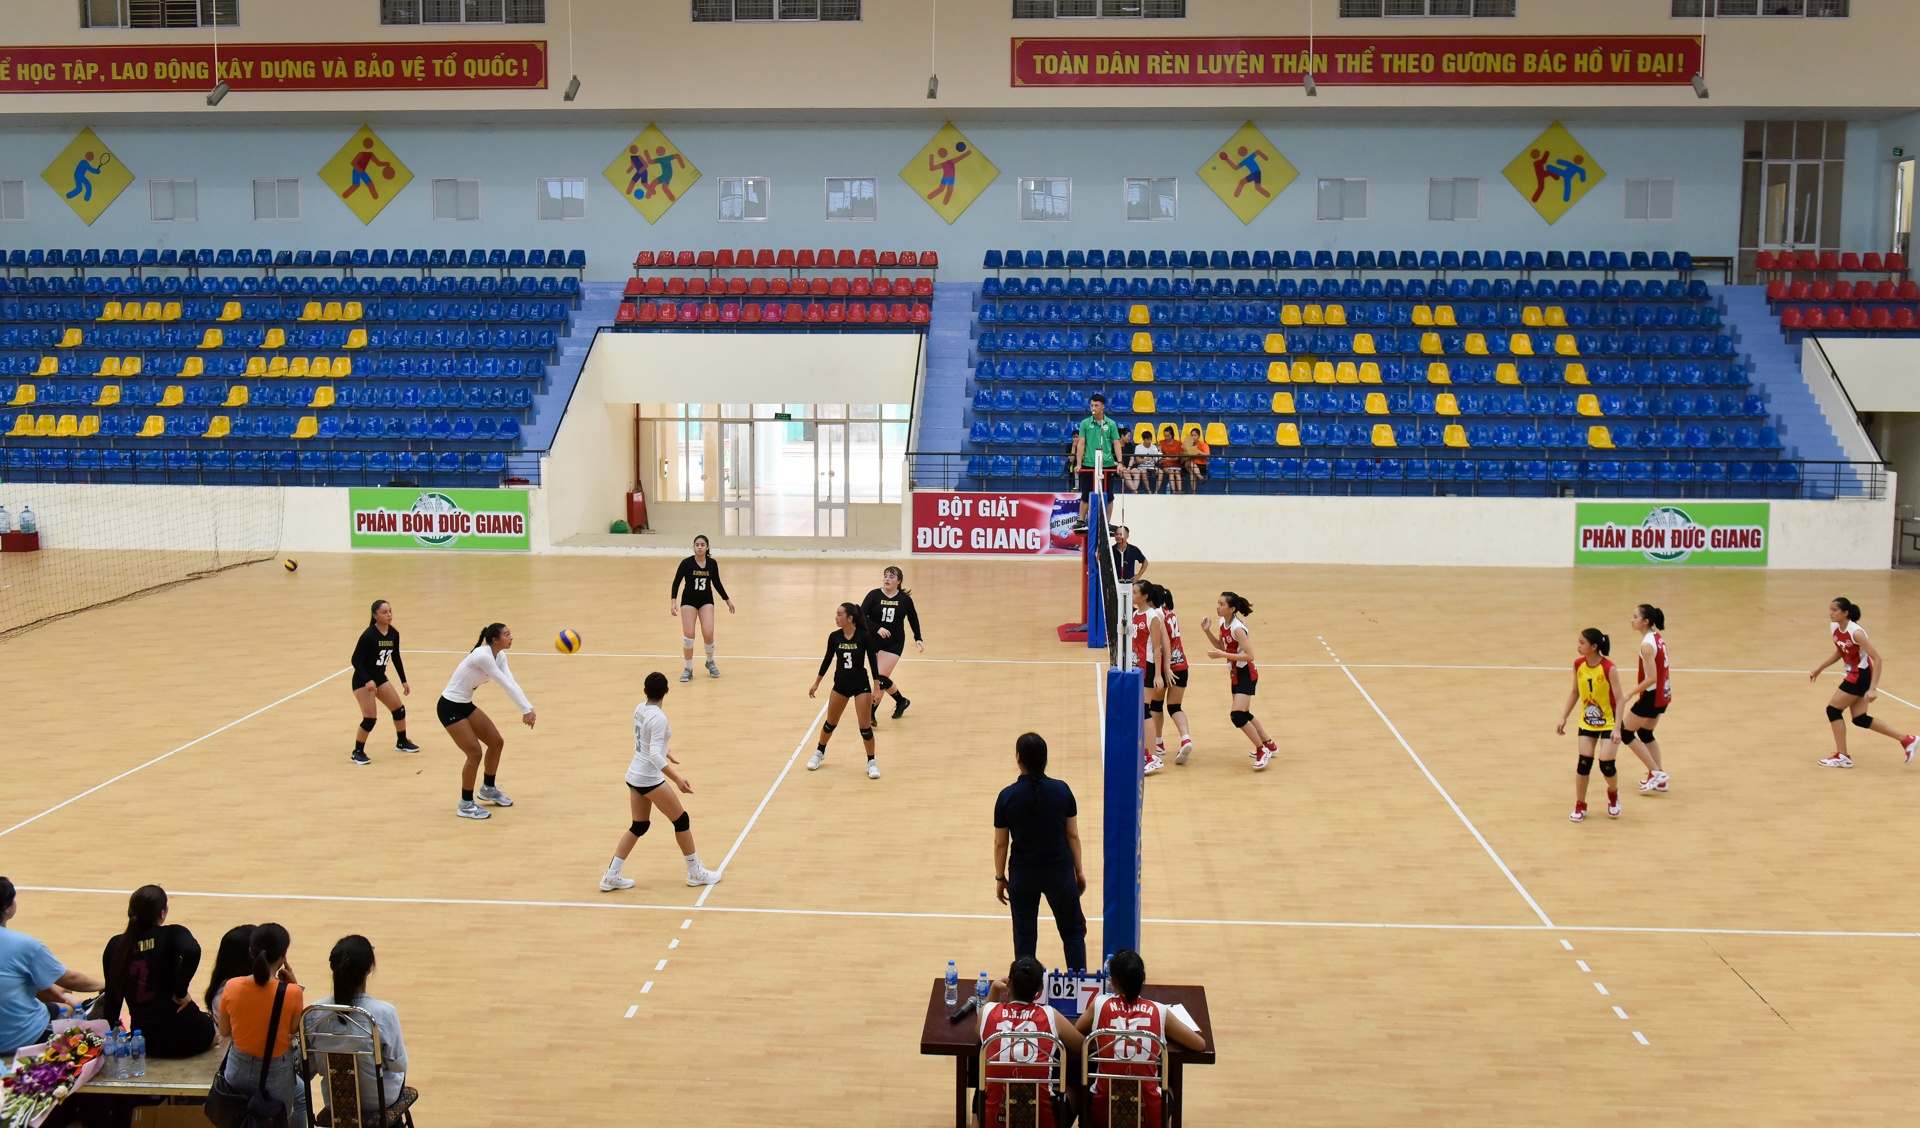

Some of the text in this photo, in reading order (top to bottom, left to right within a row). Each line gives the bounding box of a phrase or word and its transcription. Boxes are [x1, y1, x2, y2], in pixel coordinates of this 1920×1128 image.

[17, 63, 56, 84] HỌC
[62, 60, 105, 83] TẬP,
[111, 61, 148, 80] LAO
[154, 58, 209, 83] ĐỘNG
[216, 57, 254, 79] XÂY
[260, 59, 316, 83] DỰNG
[321, 57, 348, 78] VÀ
[354, 52, 395, 78] BẢO
[401, 55, 426, 81] VỆ
[432, 52, 457, 77] TỔ
[1033, 51, 1089, 75] TOÀN
[1096, 50, 1140, 75] DÂN
[1147, 50, 1190, 75] RÈN
[1197, 50, 1265, 78] LUYỆN
[1272, 50, 1328, 74] THÂN
[1335, 46, 1375, 74] THỂ
[1381, 53, 1435, 74] THEO
[1442, 51, 1516, 73] GƯƠNG
[1523, 49, 1567, 73] BÁC
[1574, 47, 1603, 73] HỒ
[1610, 49, 1631, 73] VĨ
[938, 496, 1020, 521] BỘT GIẶT
[356, 510, 524, 534] PHÂN BÓN ĐỨC GIANG
[917, 521, 1042, 550] ĐỨC GIANG
[1582, 525, 1762, 549] PHÂN BÓN ĐỨC GIANG
[694, 577, 707, 591] 13
[881, 607, 896, 623] 19
[843, 651, 853, 669] 3
[1587, 678, 1593, 692] 1
